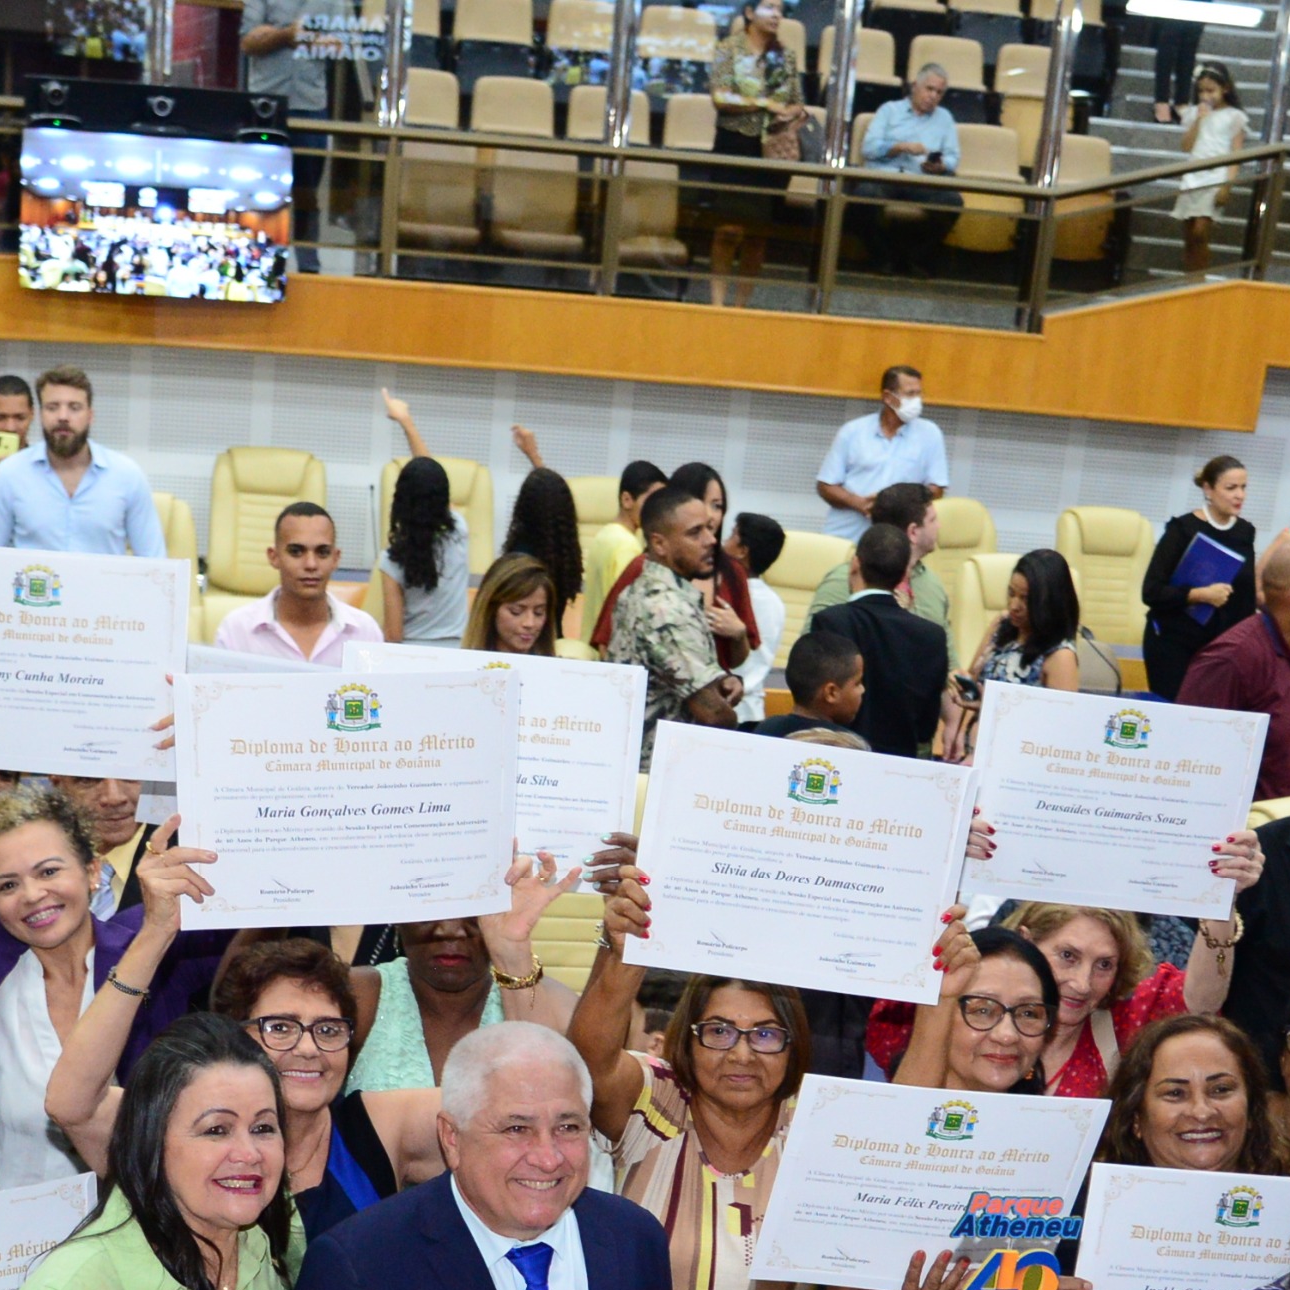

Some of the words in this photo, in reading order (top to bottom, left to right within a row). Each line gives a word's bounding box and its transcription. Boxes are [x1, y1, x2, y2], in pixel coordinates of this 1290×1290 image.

[14, 669, 53, 682] Cunha
[59, 672, 104, 685] Moreira
[230, 739, 303, 756] Diploma
[309, 738, 327, 753] de
[333, 737, 388, 755] Honra
[394, 739, 412, 751] ao
[417, 734, 474, 752] Mérito
[264, 760, 311, 772] Câmara
[315, 758, 375, 772] Municipal
[378, 759, 392, 769] de
[395, 756, 440, 769] Goiânia
[255, 806, 295, 818] Maria
[300, 804, 366, 818] Gonçalves
[370, 803, 413, 815] Gomes
[418, 801, 450, 813] Lima
[693, 793, 762, 817] Diploma
[767, 804, 785, 820] de
[789, 806, 841, 828] Honra
[845, 818, 864, 831] ao
[867, 817, 922, 838] Mérito
[723, 819, 766, 835] Câmara
[768, 825, 826, 843] Municipal
[829, 834, 841, 845] de
[844, 835, 888, 851] Goiânia
[711, 862, 747, 876] Silvia
[750, 867, 771, 878] das
[774, 870, 809, 883] Dores
[813, 875, 884, 893] Damasceno
[853, 1192, 891, 1204] Maria
[894, 1196, 925, 1208] Félix
[969, 1192, 1064, 1218] Parque
[952, 1213, 1082, 1238] Atheneu
